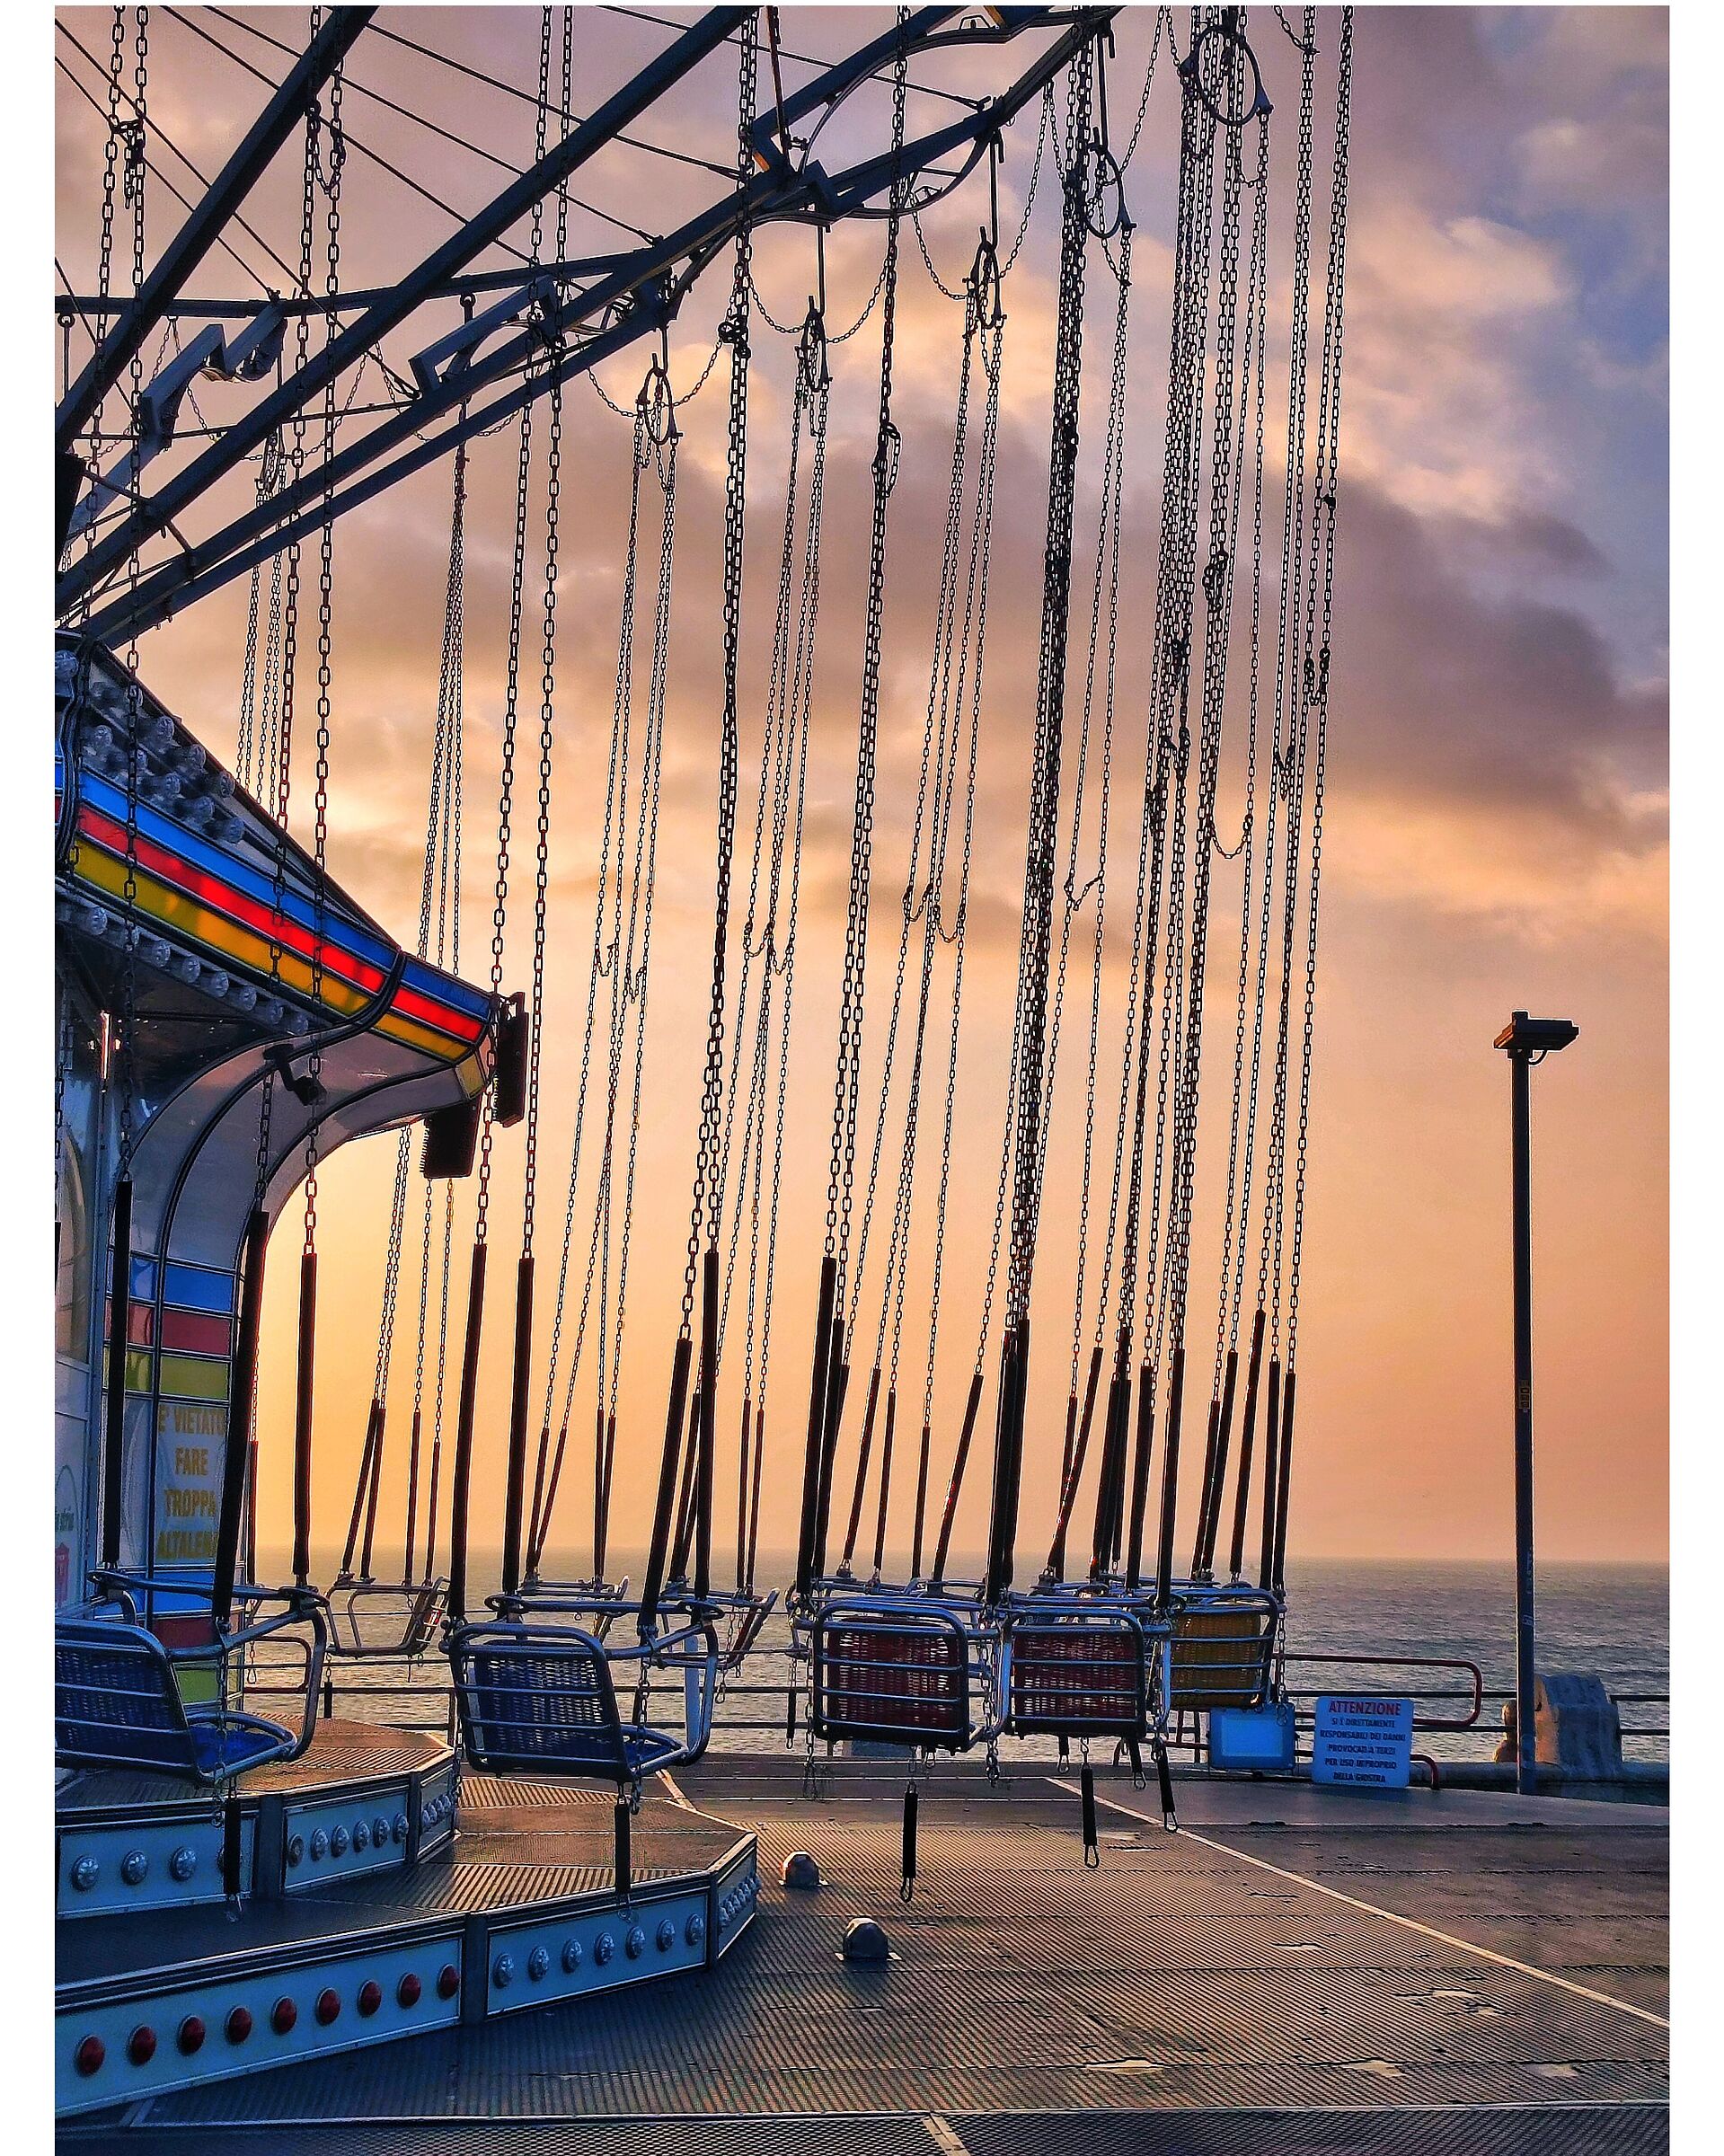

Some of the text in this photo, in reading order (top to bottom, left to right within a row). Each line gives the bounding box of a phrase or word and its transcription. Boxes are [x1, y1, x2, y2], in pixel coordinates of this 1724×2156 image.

[175, 1446, 208, 1475] FARE
[164, 1489, 216, 1517] TROPPA
[1329, 1700, 1401, 1716] ATTENZIONE
[1320, 1729, 1368, 1741] RESPONSABILI
[1370, 1731, 1381, 1741] DEI
[1325, 1757, 1338, 1766] PER
[1339, 1758, 1355, 1768] USO
[1333, 1772, 1386, 1783] DELLA GIOSTRA
